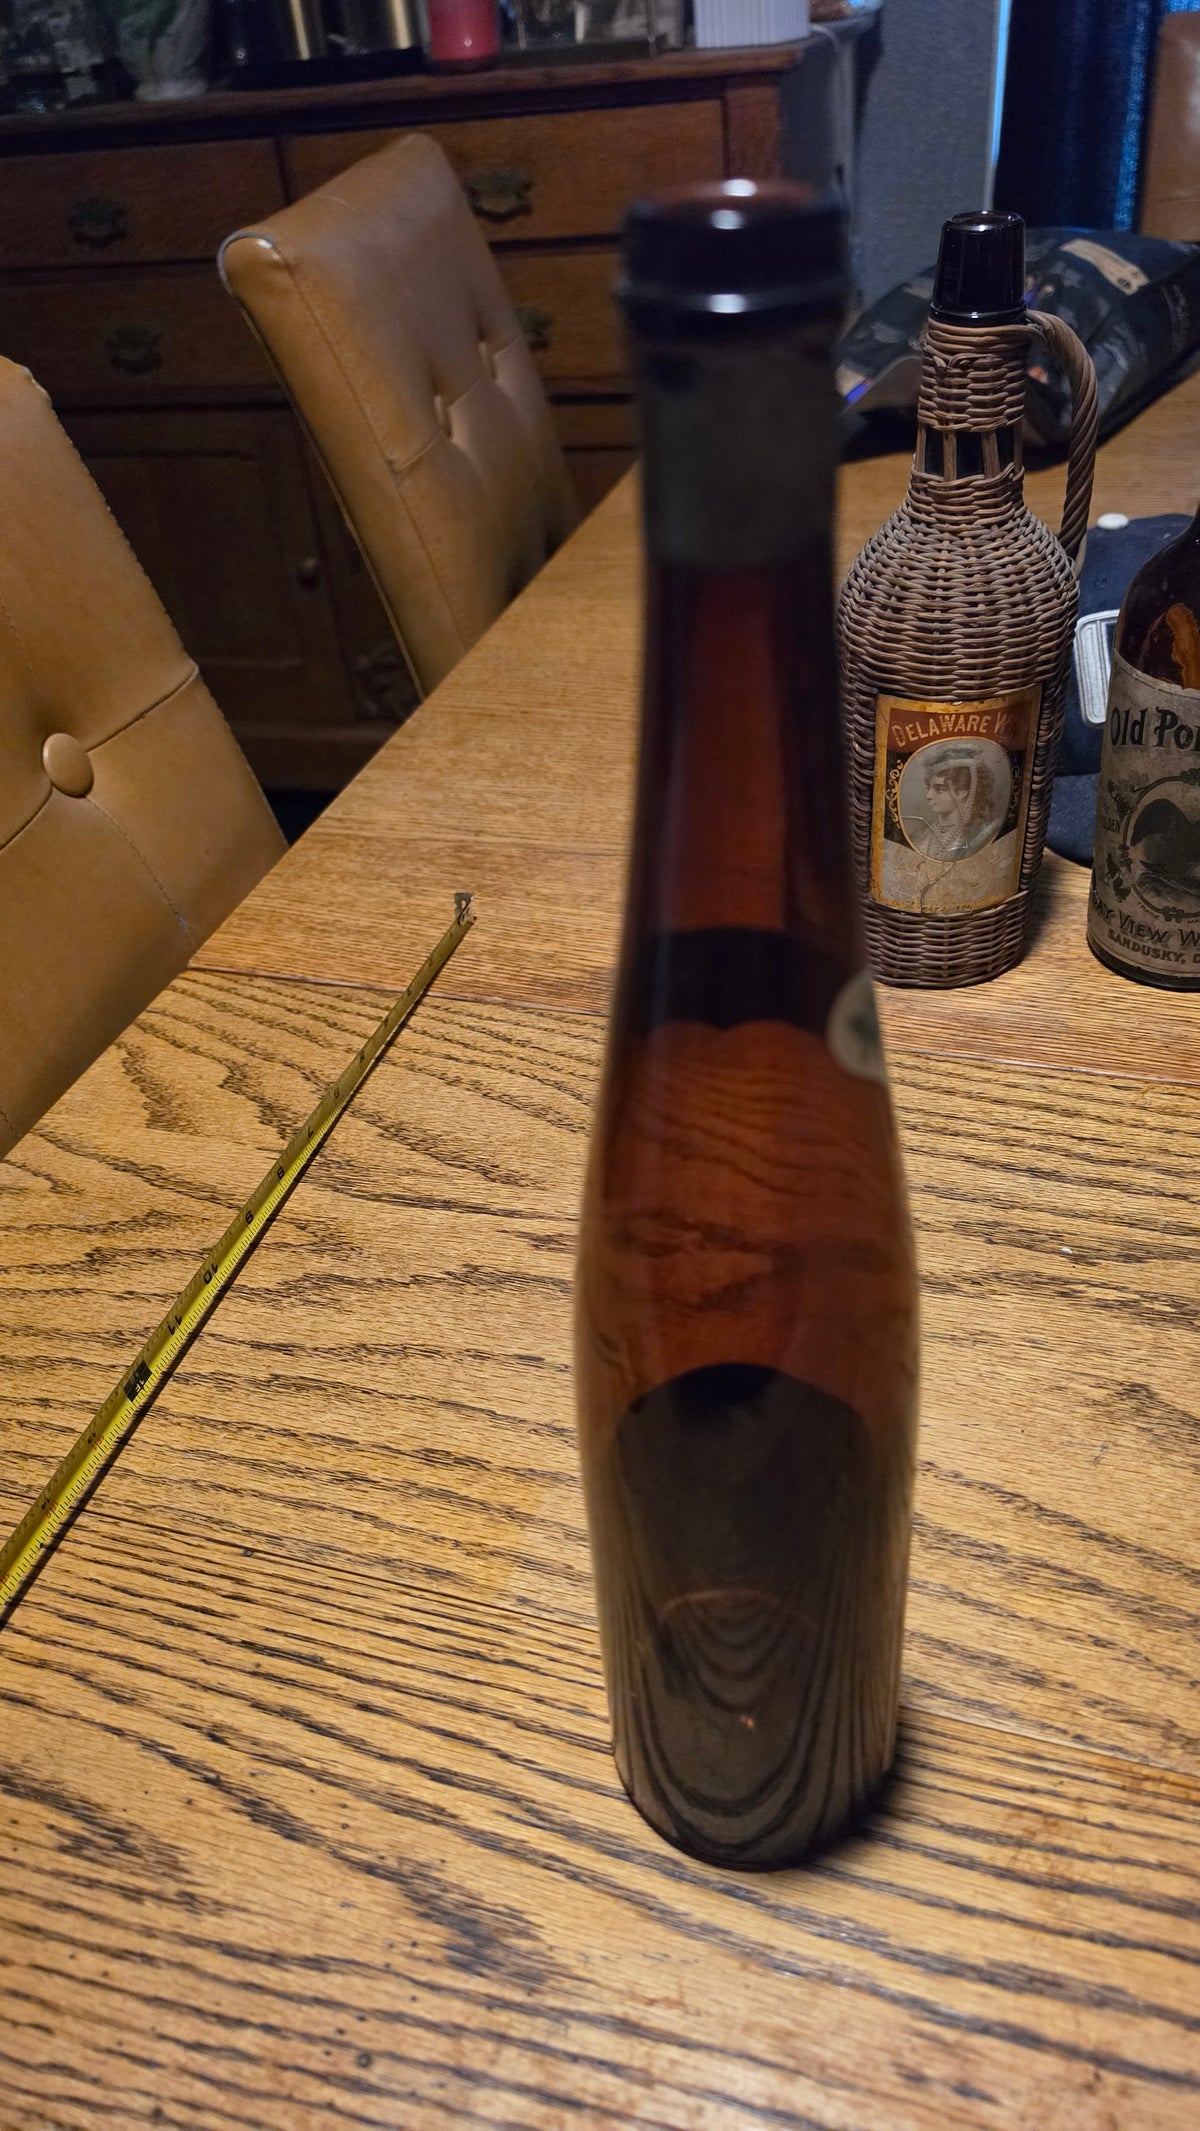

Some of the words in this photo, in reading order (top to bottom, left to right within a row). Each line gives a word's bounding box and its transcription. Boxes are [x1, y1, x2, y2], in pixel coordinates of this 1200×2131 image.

[891, 714, 992, 747] DELAWARE
[1110, 706, 1148, 747] Old
[1119, 909, 1170, 944] VIEW
[1107, 928, 1186, 965] SANDUSKY,
[202, 1262, 219, 1286] 10
[167, 1314, 183, 1336] 11
